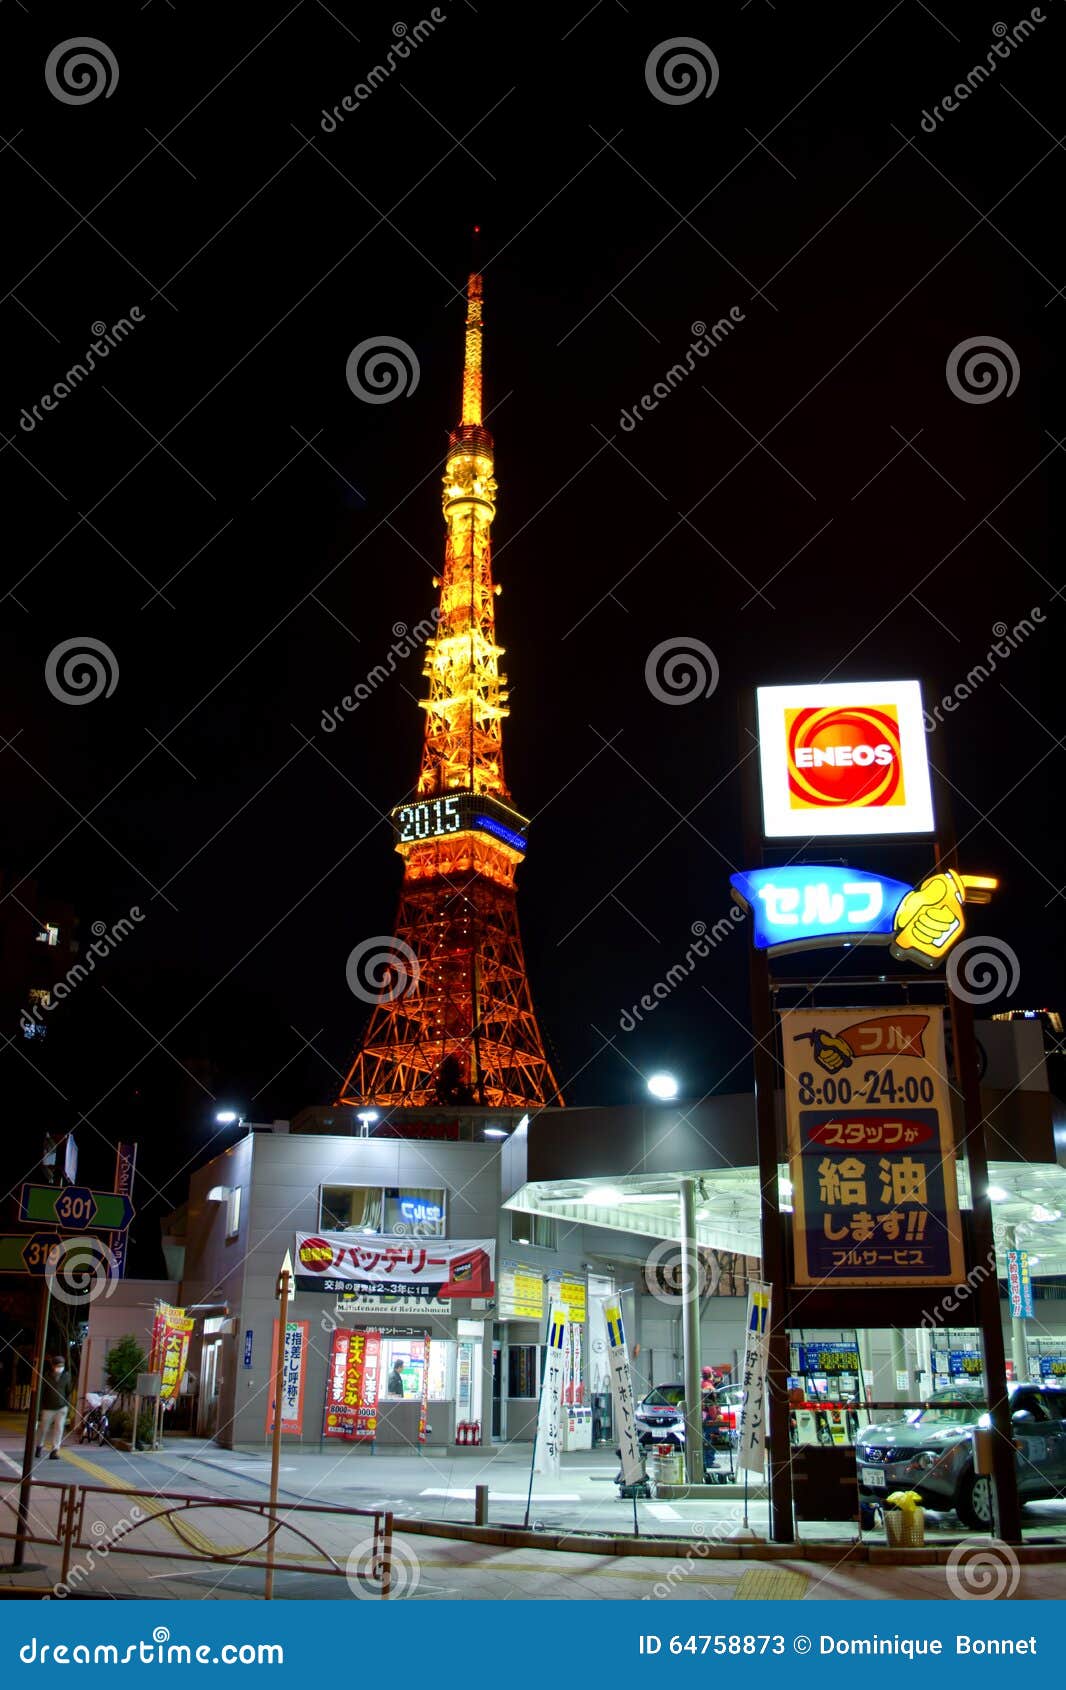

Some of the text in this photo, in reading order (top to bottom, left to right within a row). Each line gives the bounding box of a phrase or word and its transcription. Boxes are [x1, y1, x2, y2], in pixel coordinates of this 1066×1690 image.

[794, 743, 892, 768] ENEOS
[401, 798, 460, 841] 2015
[758, 881, 884, 926] セルフ
[857, 1024, 912, 1053] フル
[824, 1122, 919, 1145] スタッフが
[818, 1156, 928, 1205] 給油
[60, 1196, 91, 1219] 301
[28, 1242, 61, 1265] 319
[333, 1245, 447, 1274] バッテリー
[831, 1250, 924, 1267] フルサービス
